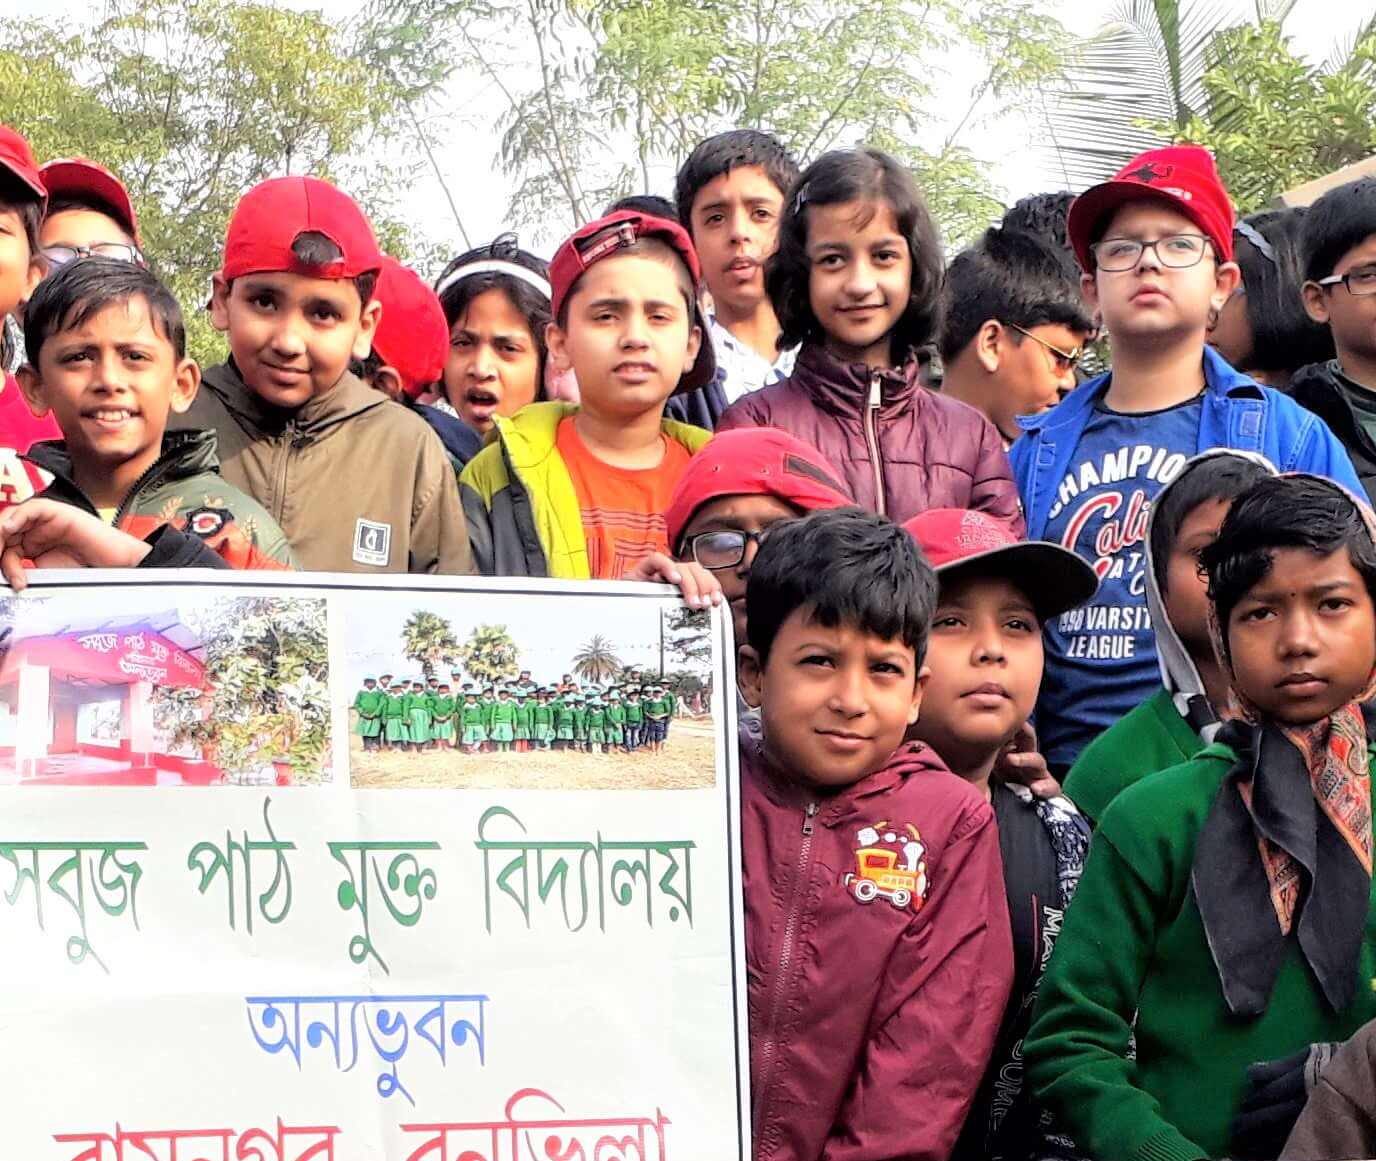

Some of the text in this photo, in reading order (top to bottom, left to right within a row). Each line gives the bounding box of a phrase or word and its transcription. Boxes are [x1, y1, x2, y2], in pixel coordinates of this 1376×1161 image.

[1048, 445, 1186, 519] CHAMPIO
[1062, 490, 1152, 556] Cali
[1066, 635, 1136, 659] LEAGUE
[1086, 607, 1152, 630] VARSIT
[186, 796, 297, 937] পাঠ
[327, 841, 442, 975] মুক্ত
[473, 806, 698, 935] বিদ্যালয়
[245, 994, 489, 1104] অন্যভুবন
